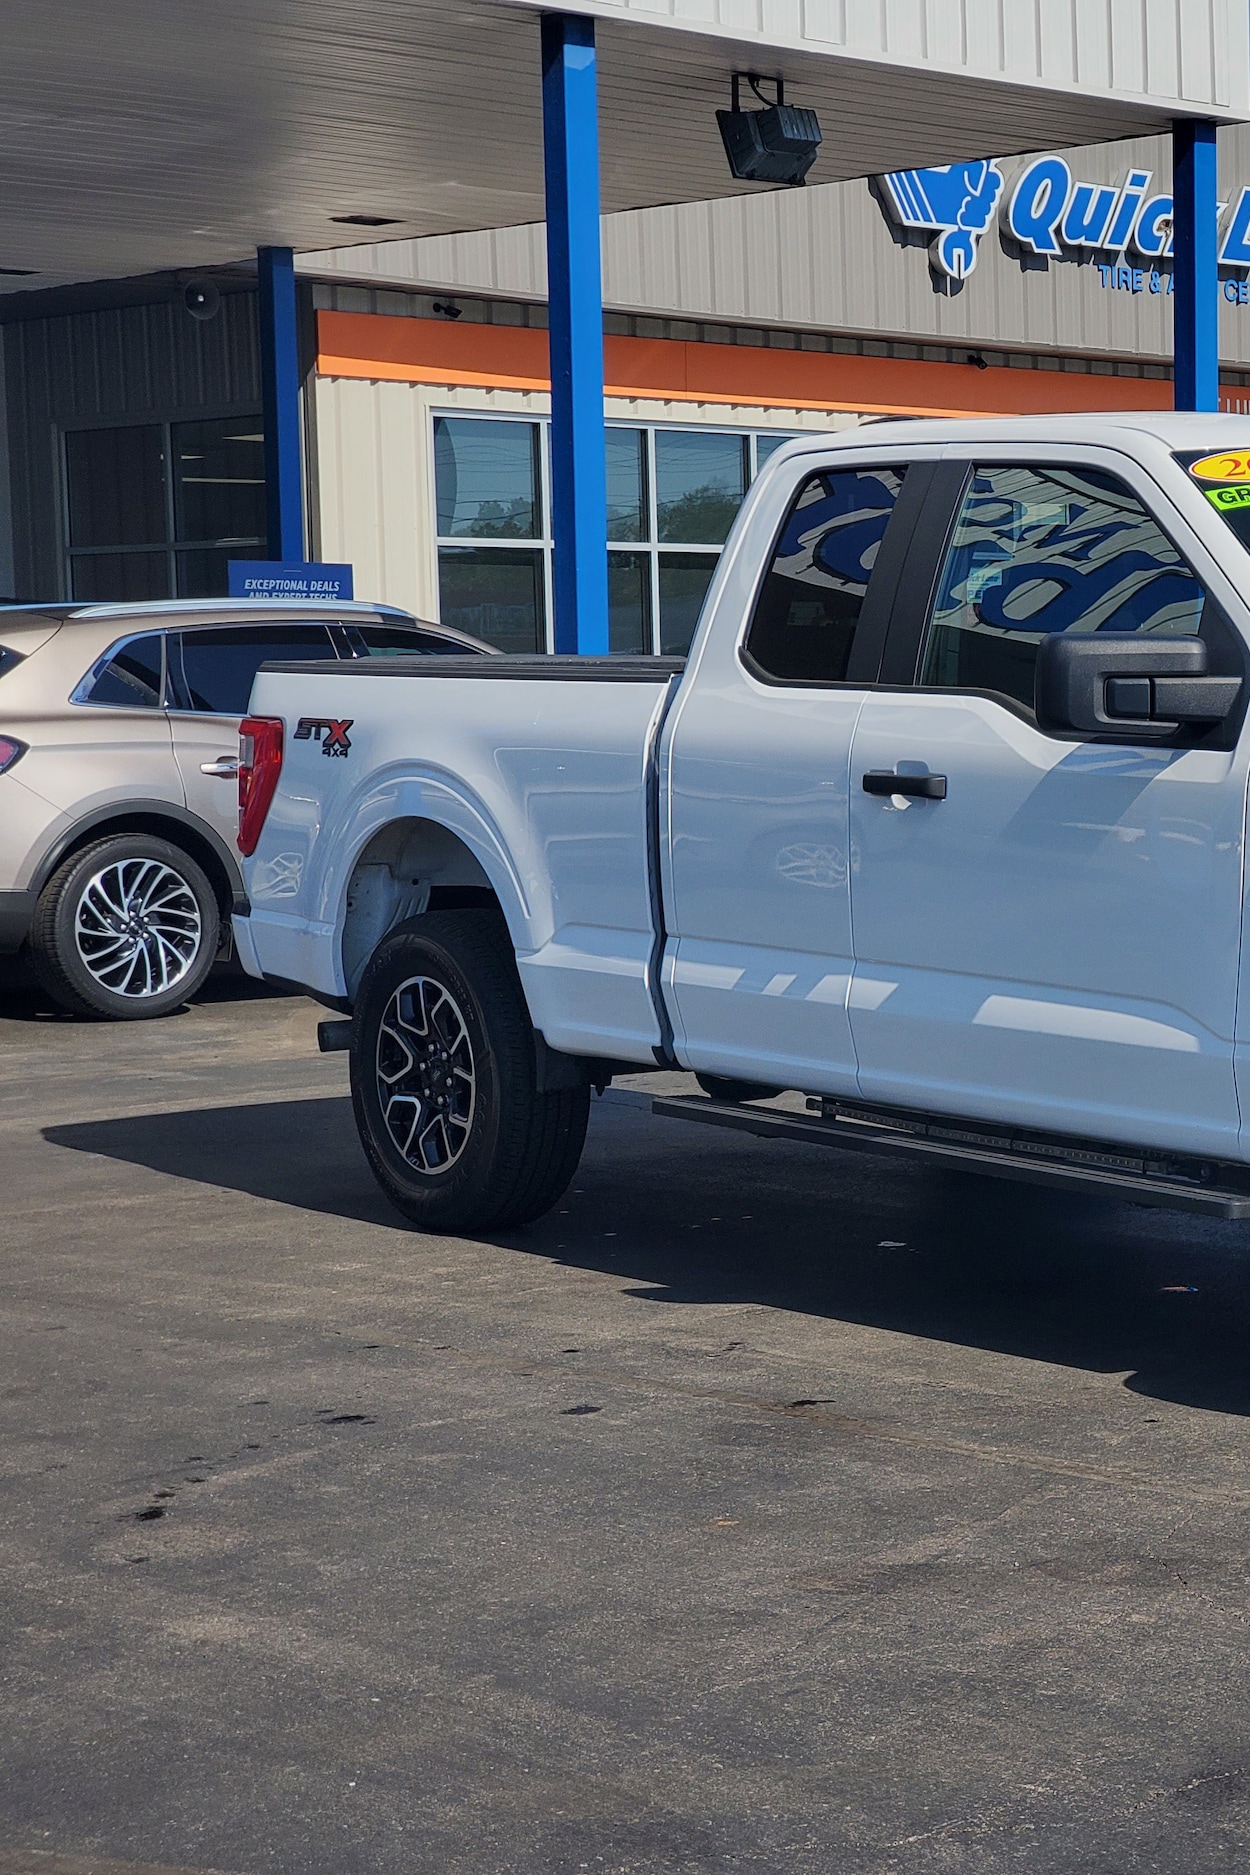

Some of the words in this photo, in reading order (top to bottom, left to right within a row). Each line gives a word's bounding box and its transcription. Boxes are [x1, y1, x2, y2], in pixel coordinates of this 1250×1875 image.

[1010, 154, 1226, 257] Quic
[1099, 264, 1144, 292] TIRE
[1150, 270, 1163, 294] &
[244, 579, 309, 592] EXCEPTIONAL
[310, 581, 340, 592] DEALS
[249, 592, 269, 600] AND
[293, 717, 355, 748] STX
